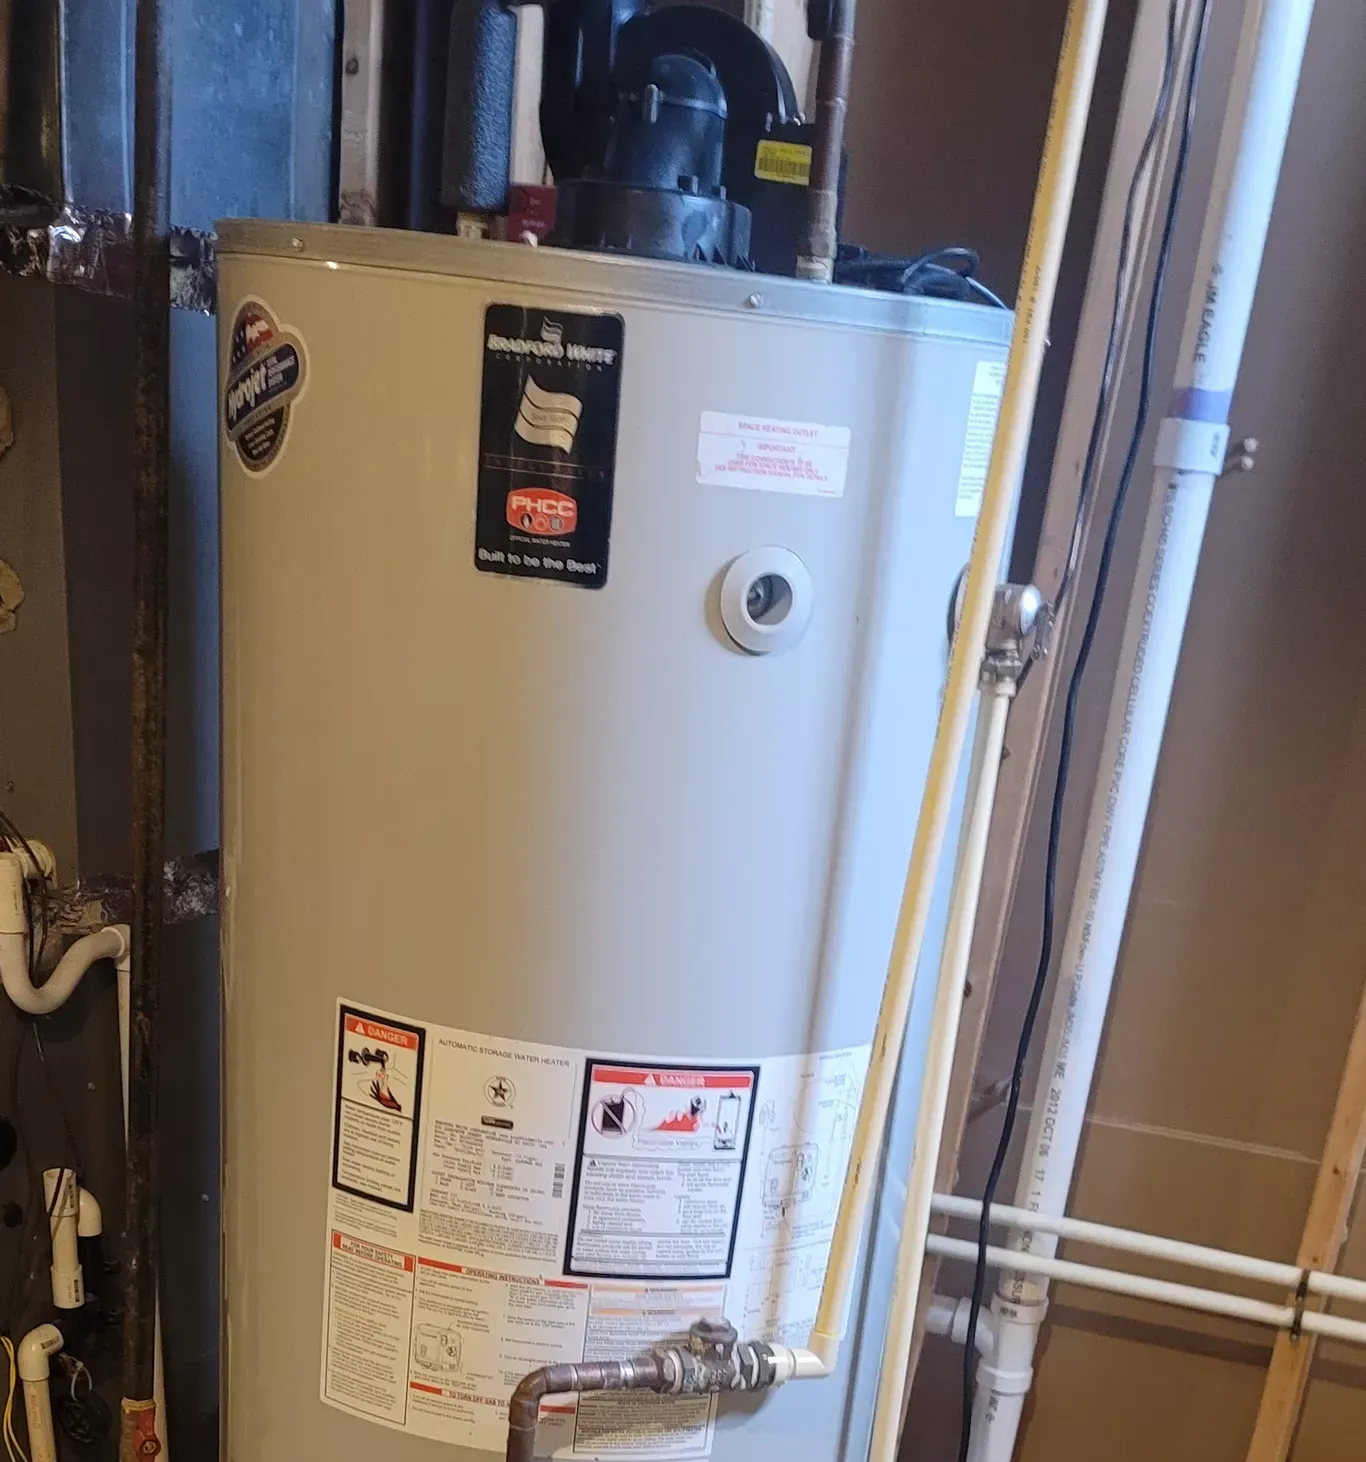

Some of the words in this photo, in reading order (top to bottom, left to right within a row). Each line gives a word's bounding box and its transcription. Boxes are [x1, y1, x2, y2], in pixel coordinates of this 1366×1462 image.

[1193, 307, 1215, 364] EAGLE
[488, 333, 564, 359] BRADFORD
[566, 343, 617, 365] WHITE
[496, 354, 602, 371] CORPORATION
[228, 362, 267, 421] Hydrojet
[762, 424, 790, 435] HEATING
[792, 427, 818, 438] OUTLET
[758, 443, 796, 454] IMPORTANT
[511, 496, 574, 517] PHCC
[478, 548, 504, 564] Built
[507, 552, 521, 566] to
[524, 554, 540, 568] be
[544, 557, 564, 571] the
[566, 558, 596, 576] Best
[1149, 547, 1165, 591] SERIES
[1132, 592, 1156, 674] COEXTRUDED
[1121, 674, 1140, 735] CELLULAR
[1114, 735, 1129, 770] CORE
[1110, 770, 1122, 794] PVC
[1093, 850, 1106, 880] ASTM
[368, 1026, 408, 1046] DANGER
[438, 1039, 478, 1054] AUTOMATIC
[480, 1046, 512, 1060] STORAGE
[514, 1052, 540, 1064] WATER
[540, 1056, 570, 1068] HEATER
[660, 1074, 706, 1088] DANGER
[1047, 1087, 1060, 1115] 2012
[1042, 1116, 1055, 1141] OCT
[1039, 1142, 1049, 1157] 06
[1034, 1167, 1045, 1182] 17
[342, 1243, 354, 1252] READ
[356, 1249, 374, 1258] BEFORE
[374, 1255, 402, 1266] OPERATING
[350, 1240, 360, 1248] FOR
[375, 1250, 392, 1258] SAFETY
[466, 1268, 498, 1280] OPERATING
[499, 1274, 540, 1286] INSTRUCTIONS
[448, 1390, 456, 1399] TO
[458, 1392, 472, 1402] TURN
[472, 1394, 484, 1404] OFF
[485, 1396, 496, 1406] GAS
[497, 1398, 506, 1408] TO
